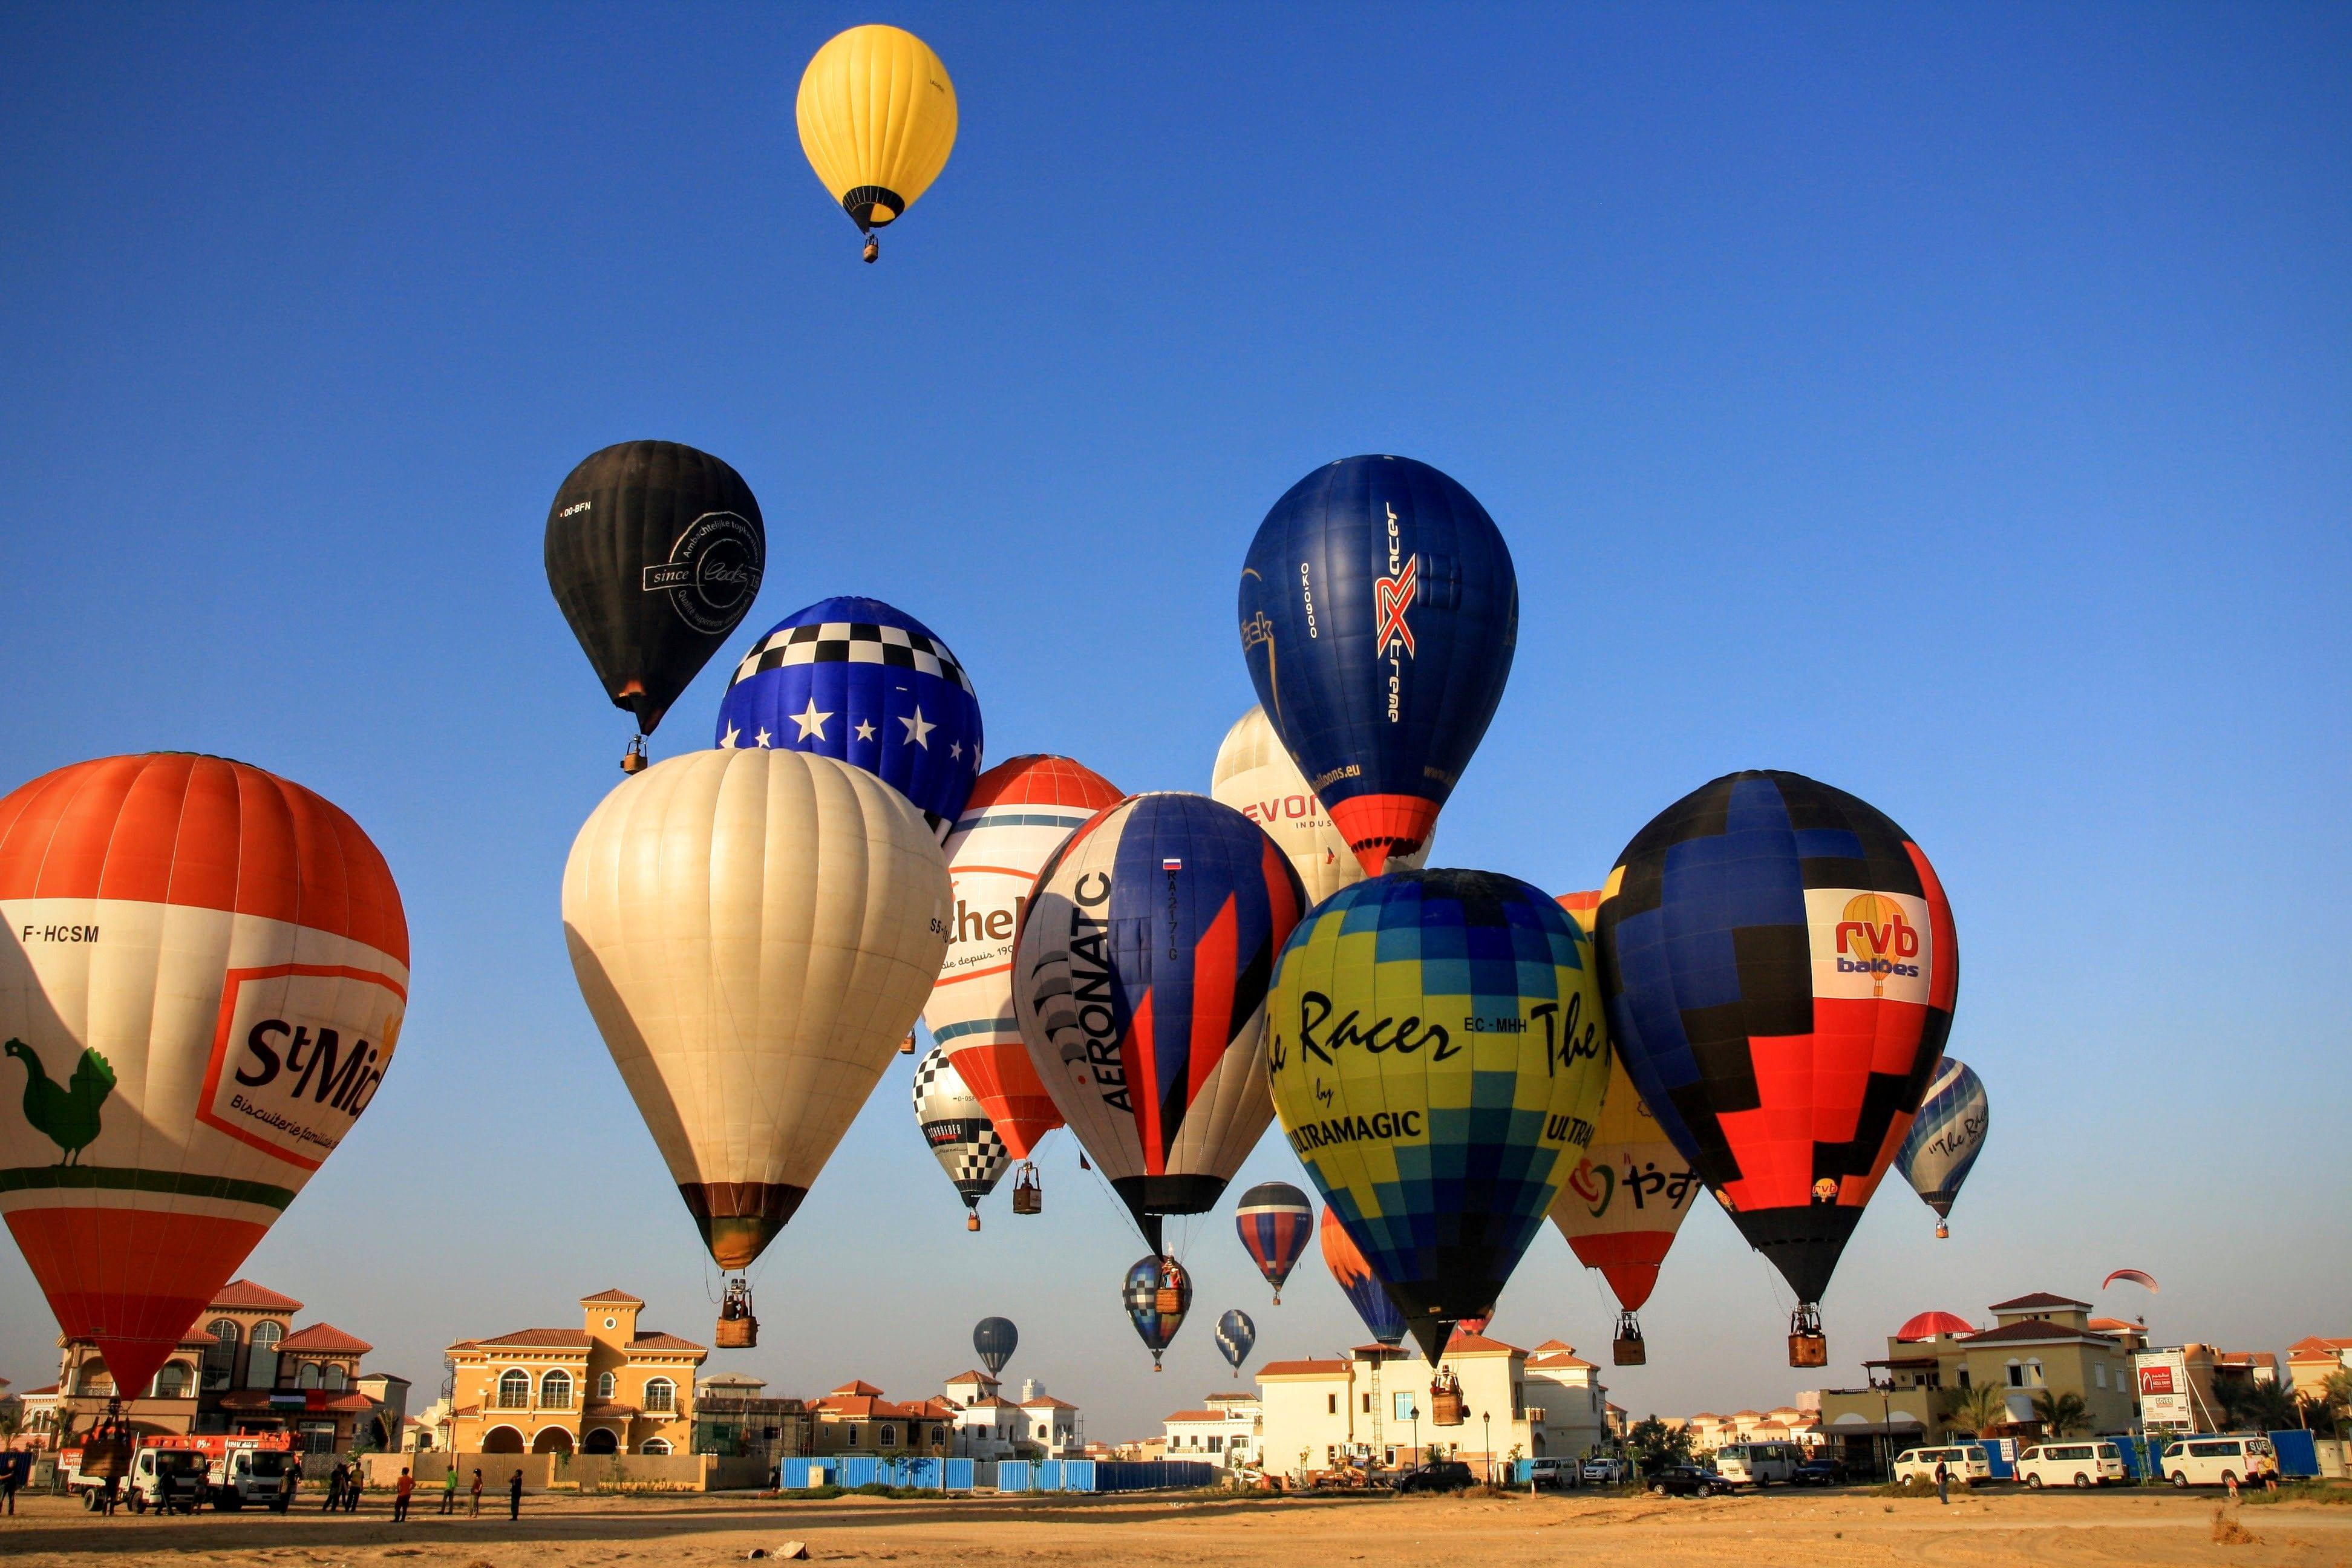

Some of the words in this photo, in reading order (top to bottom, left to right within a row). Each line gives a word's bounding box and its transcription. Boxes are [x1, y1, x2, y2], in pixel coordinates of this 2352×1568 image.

[653, 569, 690, 583] since
[1301, 563, 1318, 639] OK-0900
[1296, 820, 1331, 829] INDUS
[22, 925, 100, 942] F-HCSM
[1835, 914, 1919, 958] rvb
[958, 952, 995, 967] depuis
[1300, 990, 1462, 1067] Racer
[1530, 991, 1599, 1079] The
[1316, 1077, 1334, 1108] by
[230, 1094, 301, 1135] Biscuiterie
[1289, 1111, 1422, 1154] ULTRAMAGIC
[1812, 1183, 1838, 1194] rvb
